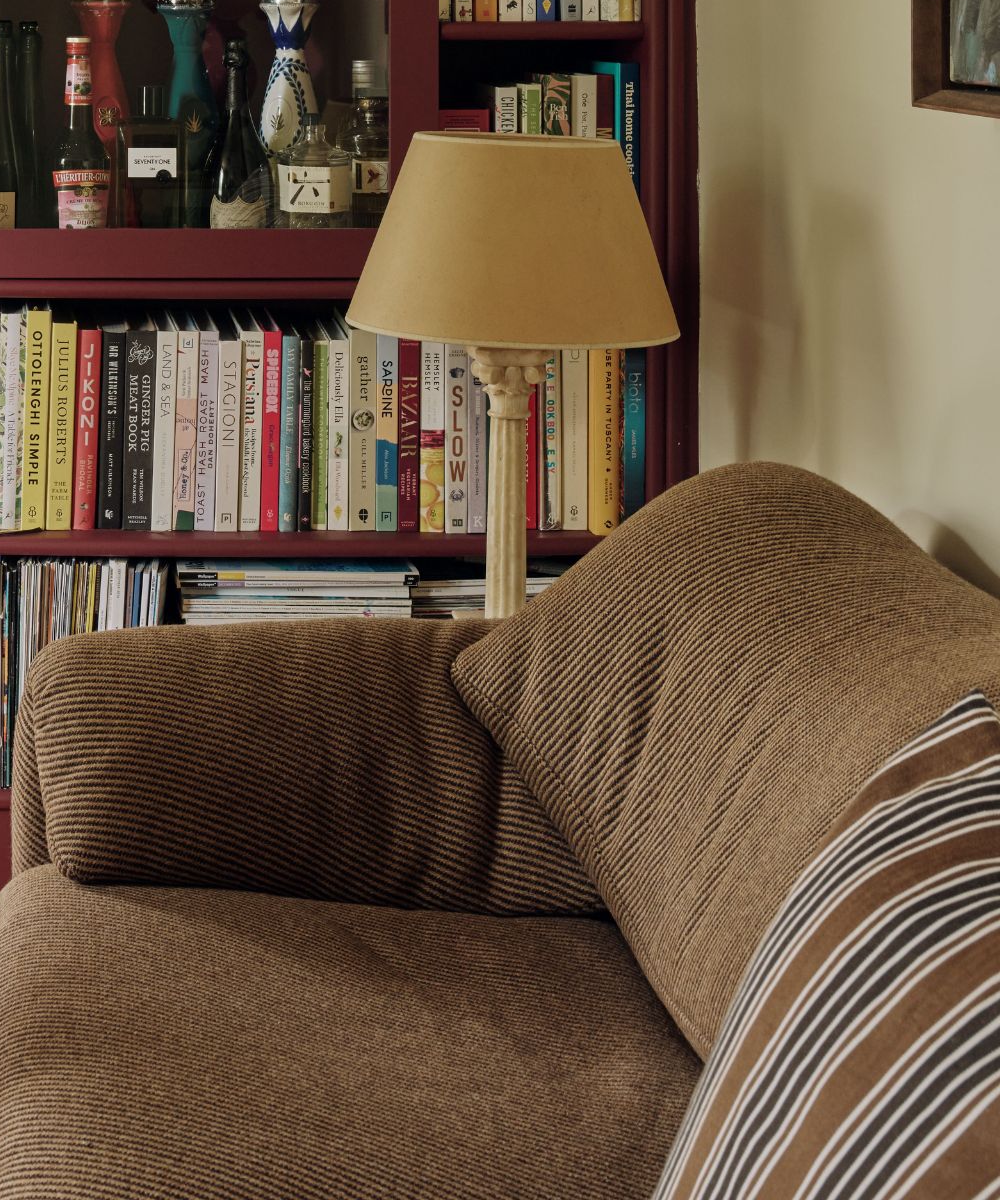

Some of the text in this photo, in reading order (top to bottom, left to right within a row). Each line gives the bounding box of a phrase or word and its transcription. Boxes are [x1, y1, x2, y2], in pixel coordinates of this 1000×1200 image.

[80, 343, 95, 446] JIKONI
[108, 344, 120, 414] MR WILKINSON'S
[161, 344, 172, 378] LAND
[244, 358, 260, 424] Persiana
[286, 348, 294, 434] MY FAMILY TABLE
[332, 352, 344, 424] Deliciously Ella
[358, 356, 371, 402] gather
[380, 360, 393, 418] SARDINE
[628, 372, 642, 414] biota
[28, 330, 42, 486] OTTOLENGHI SIMPLE
[56, 340, 70, 465] JULIUS ROBERTS
[128, 374, 139, 452] MEAT BOOK
[140, 374, 152, 452] GINGER PIG
[160, 396, 170, 418] SEA
[222, 362, 236, 447] STAGIONI
[301, 380, 312, 494] the hummingbird bakery cookbook
[400, 376, 418, 458] BAZAAR
[450, 386, 466, 482] SLOW
[86, 454, 94, 495] RAVINDER
[198, 442, 206, 474] HASH
[196, 484, 205, 523] TOAST
